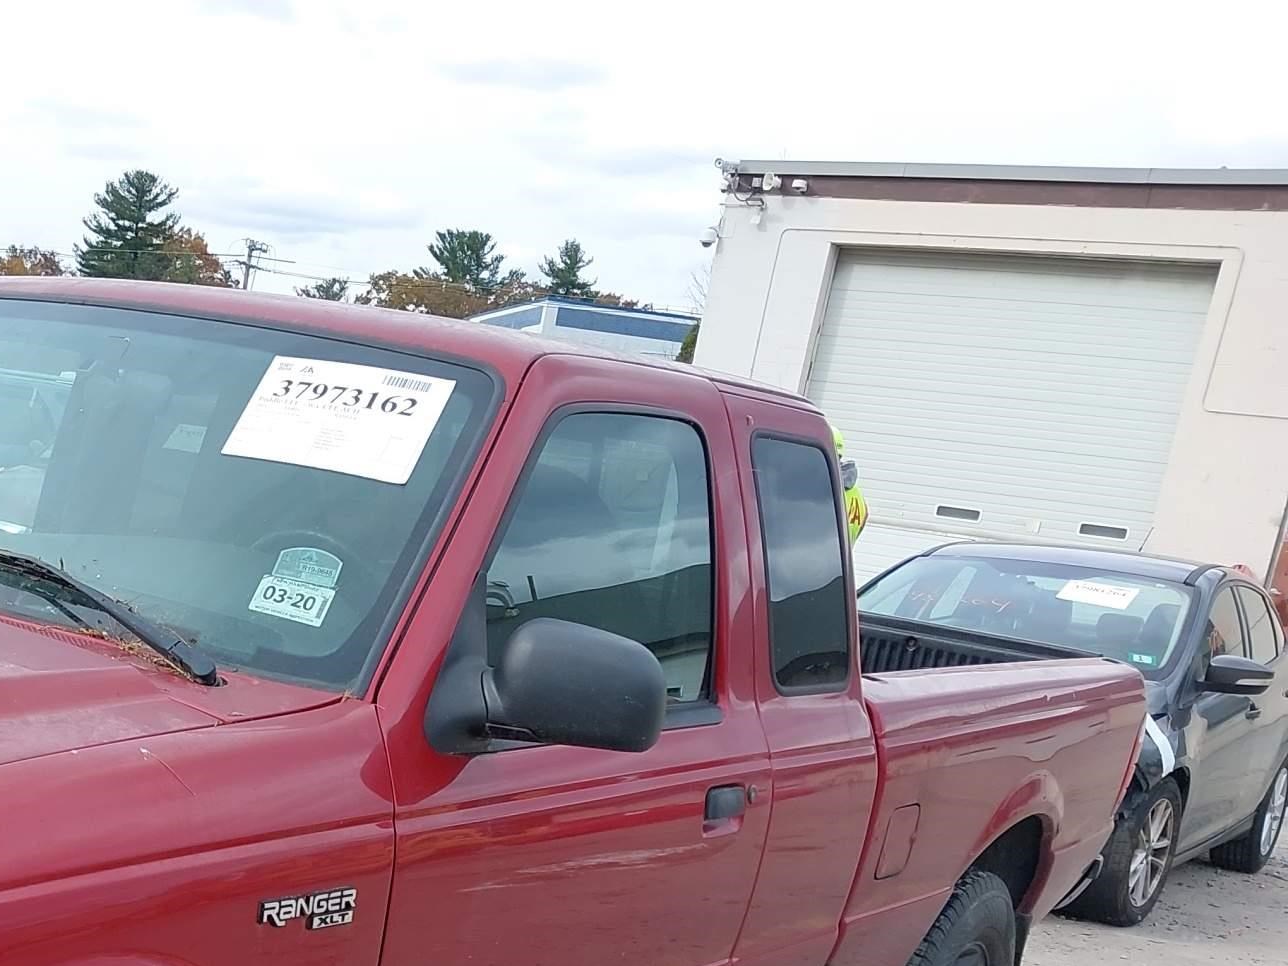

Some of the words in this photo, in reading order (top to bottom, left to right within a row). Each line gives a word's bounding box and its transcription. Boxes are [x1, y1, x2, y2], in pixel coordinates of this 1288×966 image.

[272, 379, 418, 417] 37973162
[262, 585, 316, 611] 03-20
[261, 887, 358, 927] RANGER
[315, 911, 352, 928] XLT
